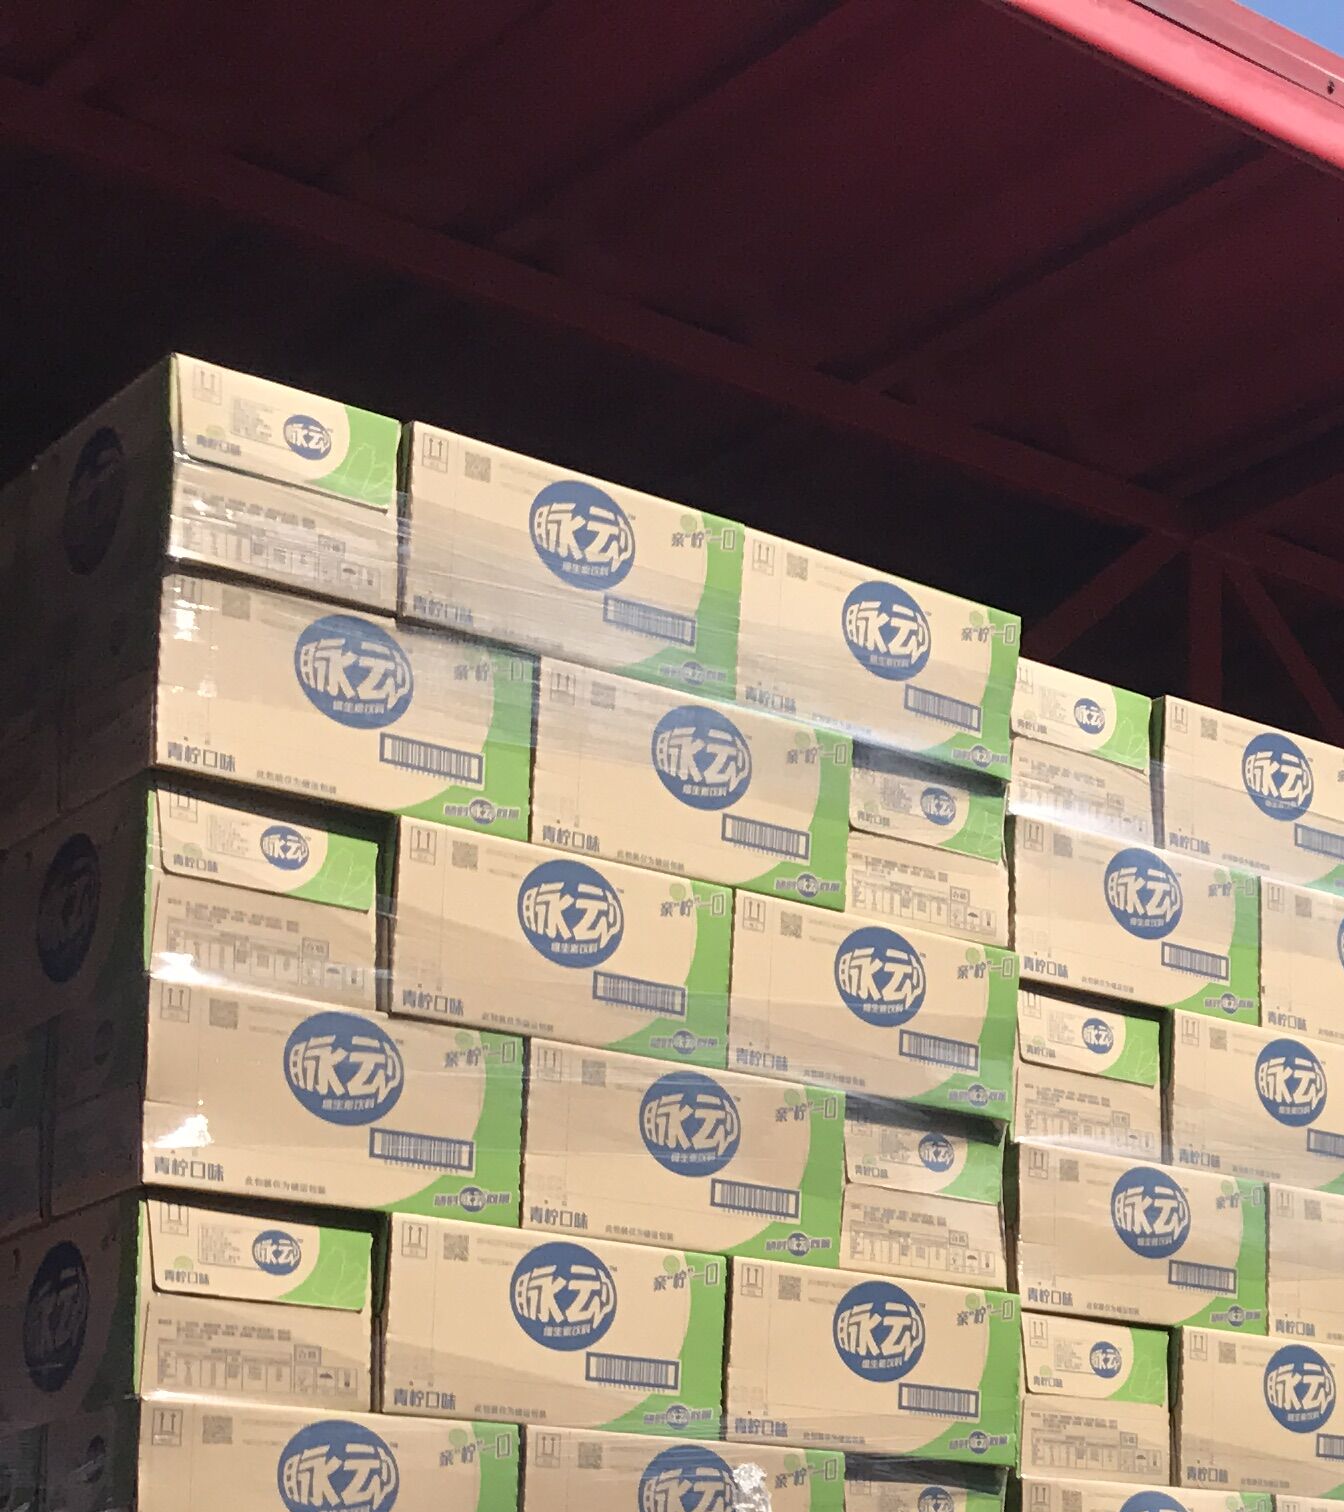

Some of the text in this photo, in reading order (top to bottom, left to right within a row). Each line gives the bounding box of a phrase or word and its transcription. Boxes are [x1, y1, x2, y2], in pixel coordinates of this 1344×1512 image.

[533, 502, 632, 570] 脉动
[845, 600, 929, 662] 脉动
[299, 636, 412, 707] 脉动
[654, 725, 750, 790] 脉动
[1244, 749, 1312, 805] 脉动
[521, 881, 621, 947] 脉动
[1106, 866, 1181, 922] 脉动
[402, 990, 464, 1016] 青柠口味
[837, 946, 924, 1006] 脉动
[288, 1033, 402, 1102] 脉动
[1257, 1056, 1324, 1110] 脉动
[642, 1091, 739, 1155] 脉动
[154, 1156, 224, 1182] 青柠口味
[530, 1206, 588, 1230] 青柠口味
[1113, 1184, 1188, 1241] 脉动
[514, 1263, 614, 1328] 脉动
[836, 1301, 923, 1360] 脉动
[394, 1388, 456, 1411] 青柠口味
[1267, 1362, 1332, 1416] 脉动
[282, 1442, 396, 1510] 脉动
